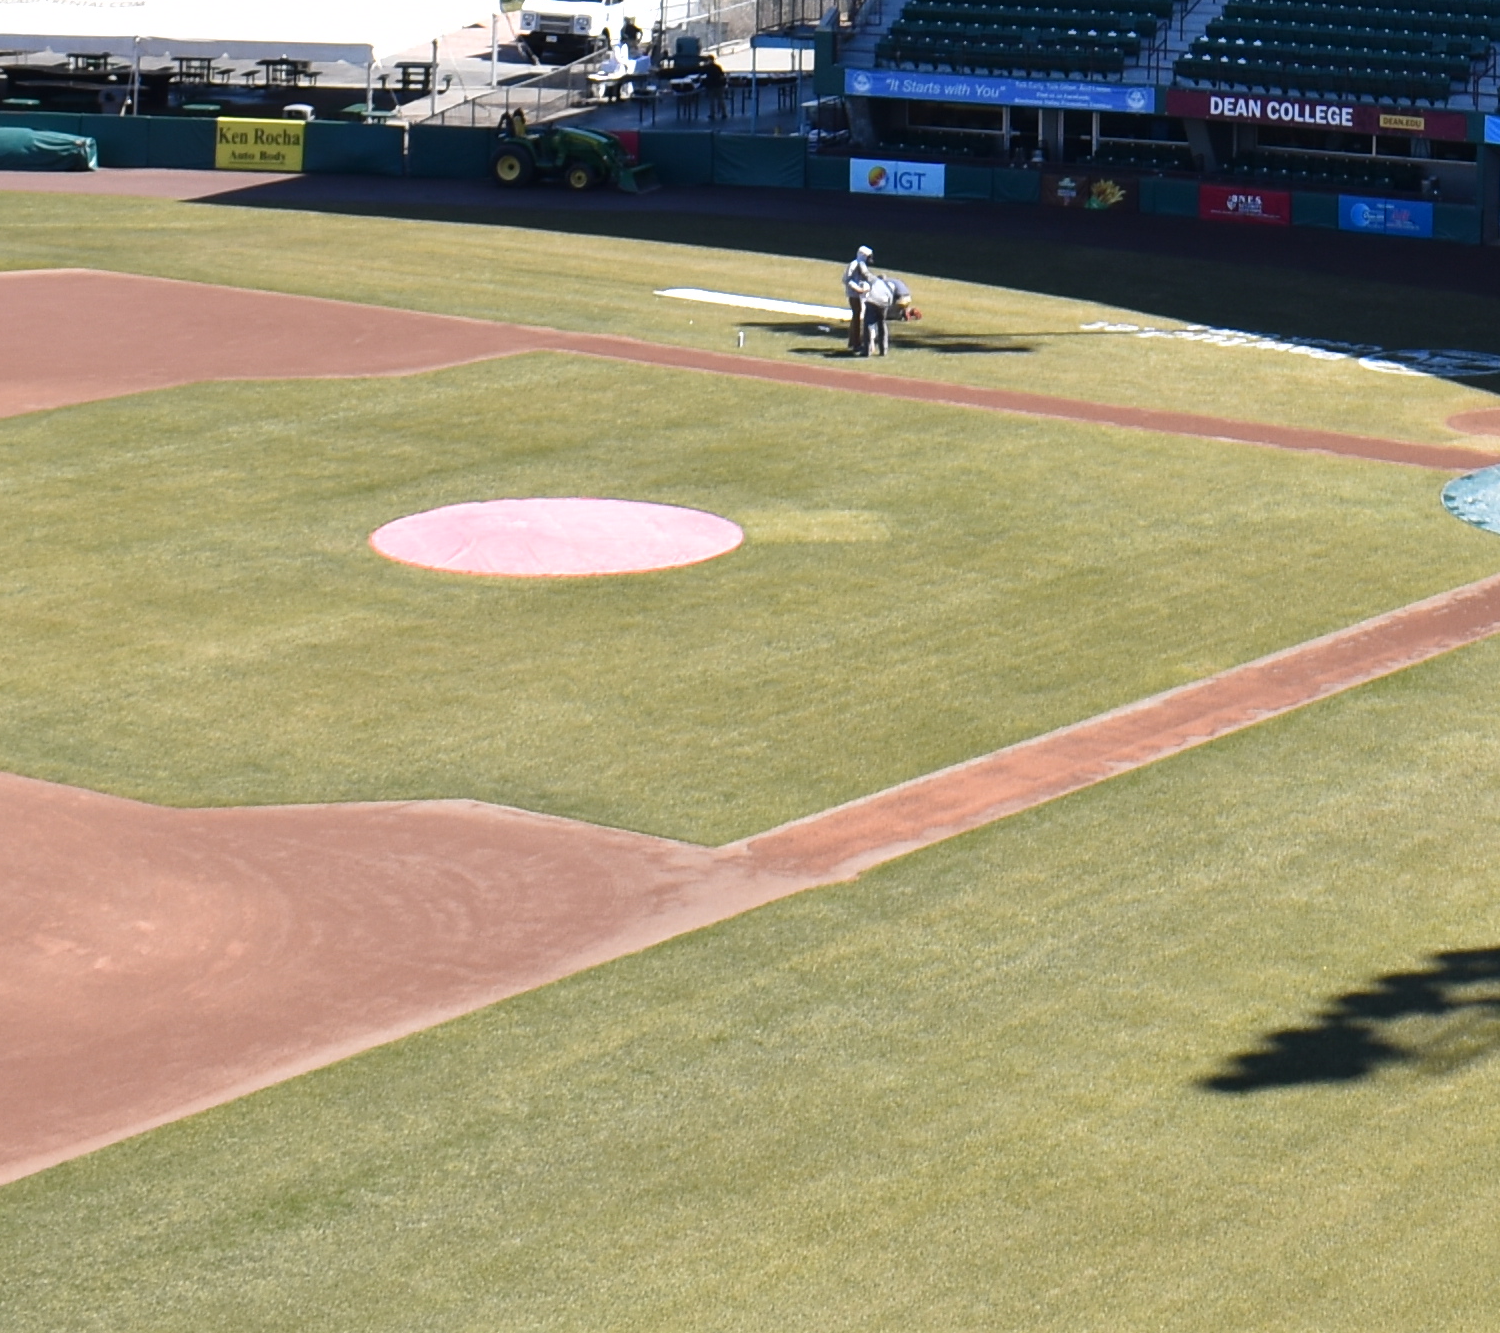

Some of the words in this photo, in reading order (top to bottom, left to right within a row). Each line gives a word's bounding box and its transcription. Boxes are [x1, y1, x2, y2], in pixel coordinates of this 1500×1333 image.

[902, 79, 941, 95] Starts
[944, 83, 970, 97] with
[1210, 95, 1261, 119] DEAN
[1266, 101, 1354, 128] COLLEGE
[1382, 117, 1422, 129] DEAN.EDU
[219, 126, 249, 145] Ken
[253, 127, 301, 146] Rocha
[230, 150, 255, 160] Auto
[259, 150, 286, 162] Body
[894, 171, 927, 190] IGT
